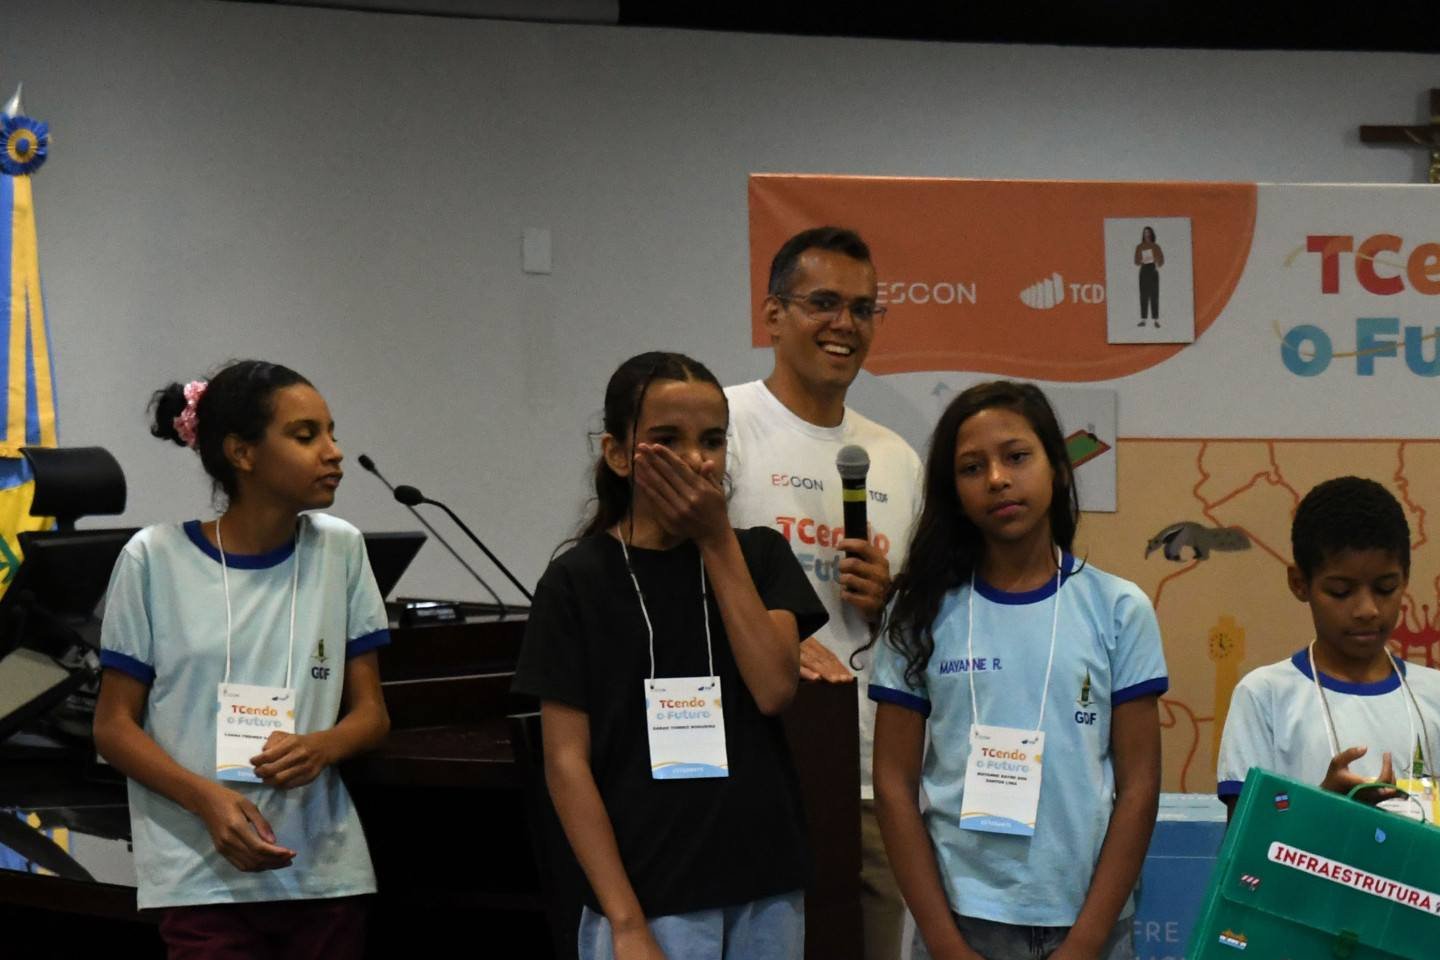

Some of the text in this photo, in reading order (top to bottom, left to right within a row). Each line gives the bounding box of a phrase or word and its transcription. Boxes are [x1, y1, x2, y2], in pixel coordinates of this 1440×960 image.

[876, 282, 1105, 305] ESCON TCD
[1280, 323, 1333, 378] o
[771, 473, 824, 491] ESCON
[775, 515, 891, 558] TCeno
[939, 657, 988, 675] MAYANNE
[231, 703, 278, 717] TCendo
[659, 696, 706, 709] TCendo
[667, 709, 711, 720] Futuro
[1074, 710, 1097, 726] GDF
[981, 747, 1027, 761] TCendo
[986, 759, 1030, 773] Futuro
[1274, 845, 1432, 911] INFRAESTRUTURA
